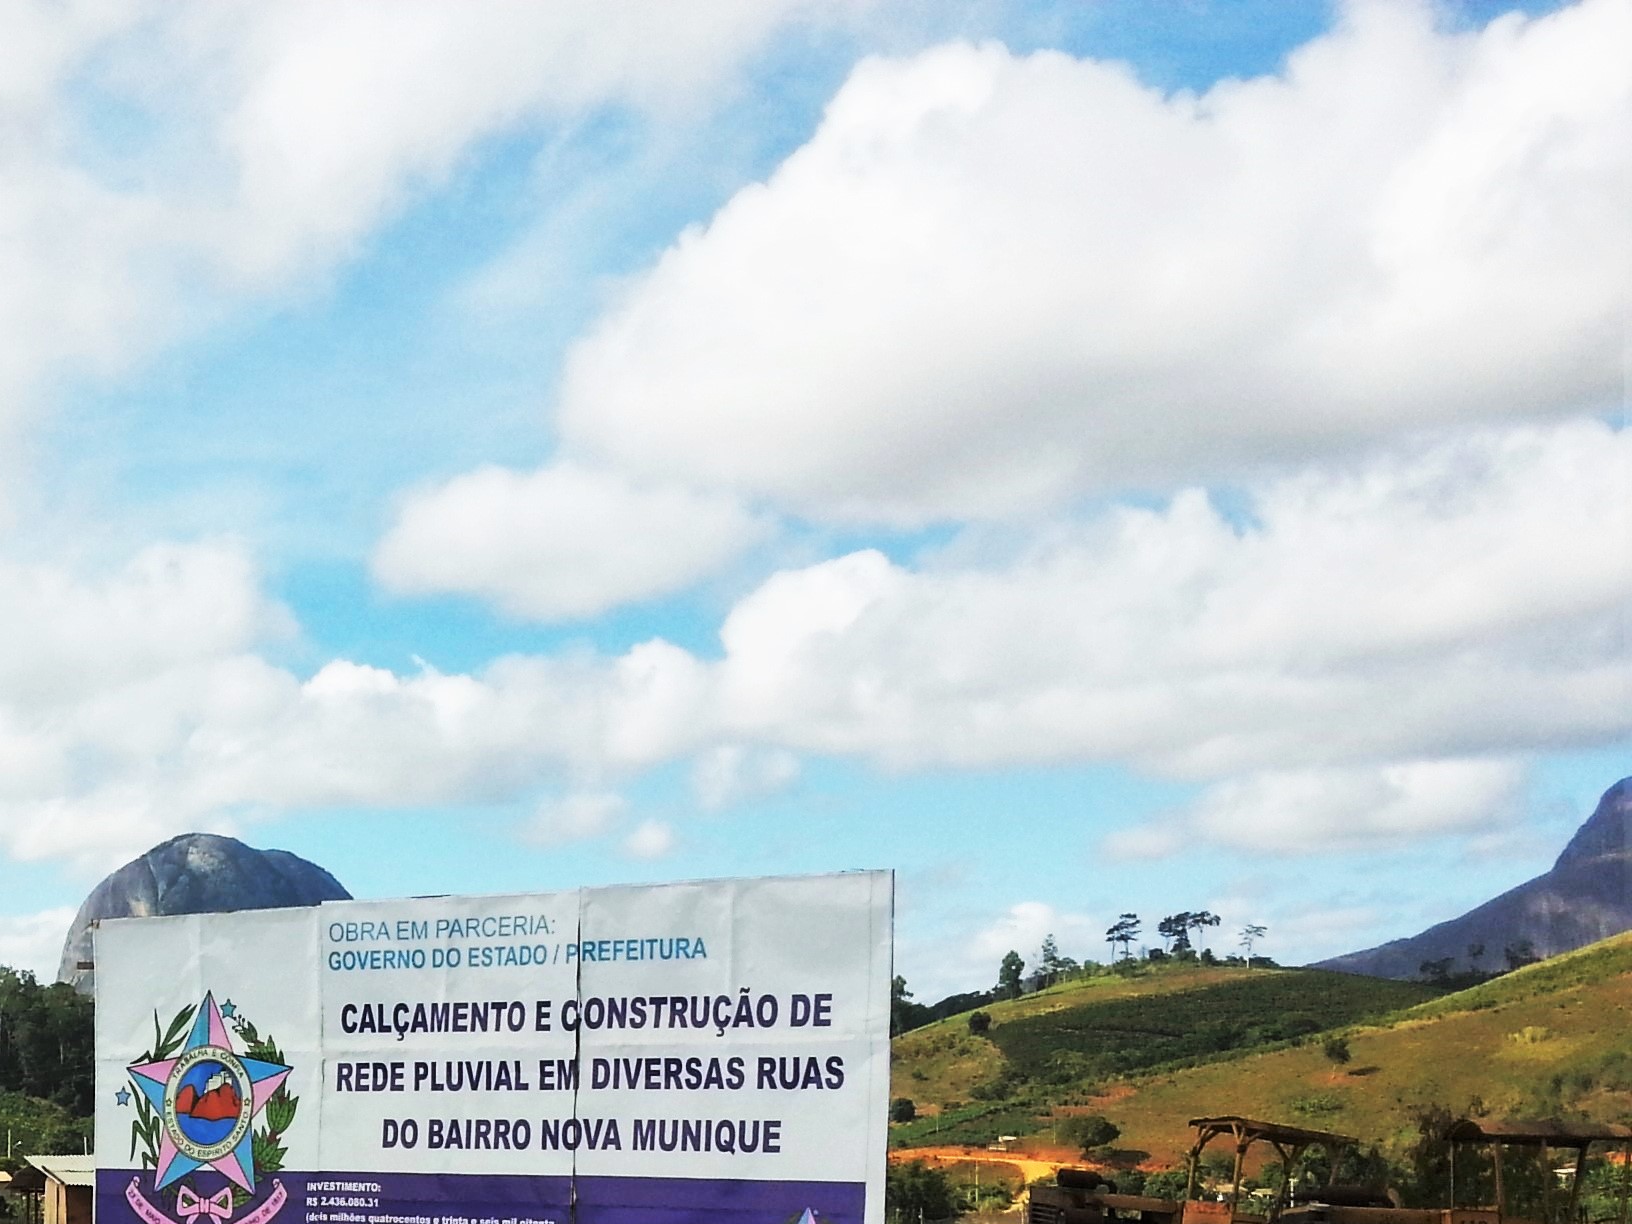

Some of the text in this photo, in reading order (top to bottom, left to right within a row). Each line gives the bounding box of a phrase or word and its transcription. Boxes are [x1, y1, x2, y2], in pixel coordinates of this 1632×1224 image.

[329, 915, 556, 942] OBRA EM PARCERIA:
[328, 937, 707, 971] GOVERNO DO ESTADO / PREFEITURA
[340, 986, 832, 1041] CALÇAMENTO E CONSTRUÇÃO DE
[336, 1055, 845, 1092] REDE PLUVIAL EM DIVERSAS RUAS
[382, 1118, 782, 1156] DO BAIRRO NOVA MUNIQUE
[306, 1181, 382, 1193] INVESTIMENTO:
[433, 1217, 440, 1224] e
